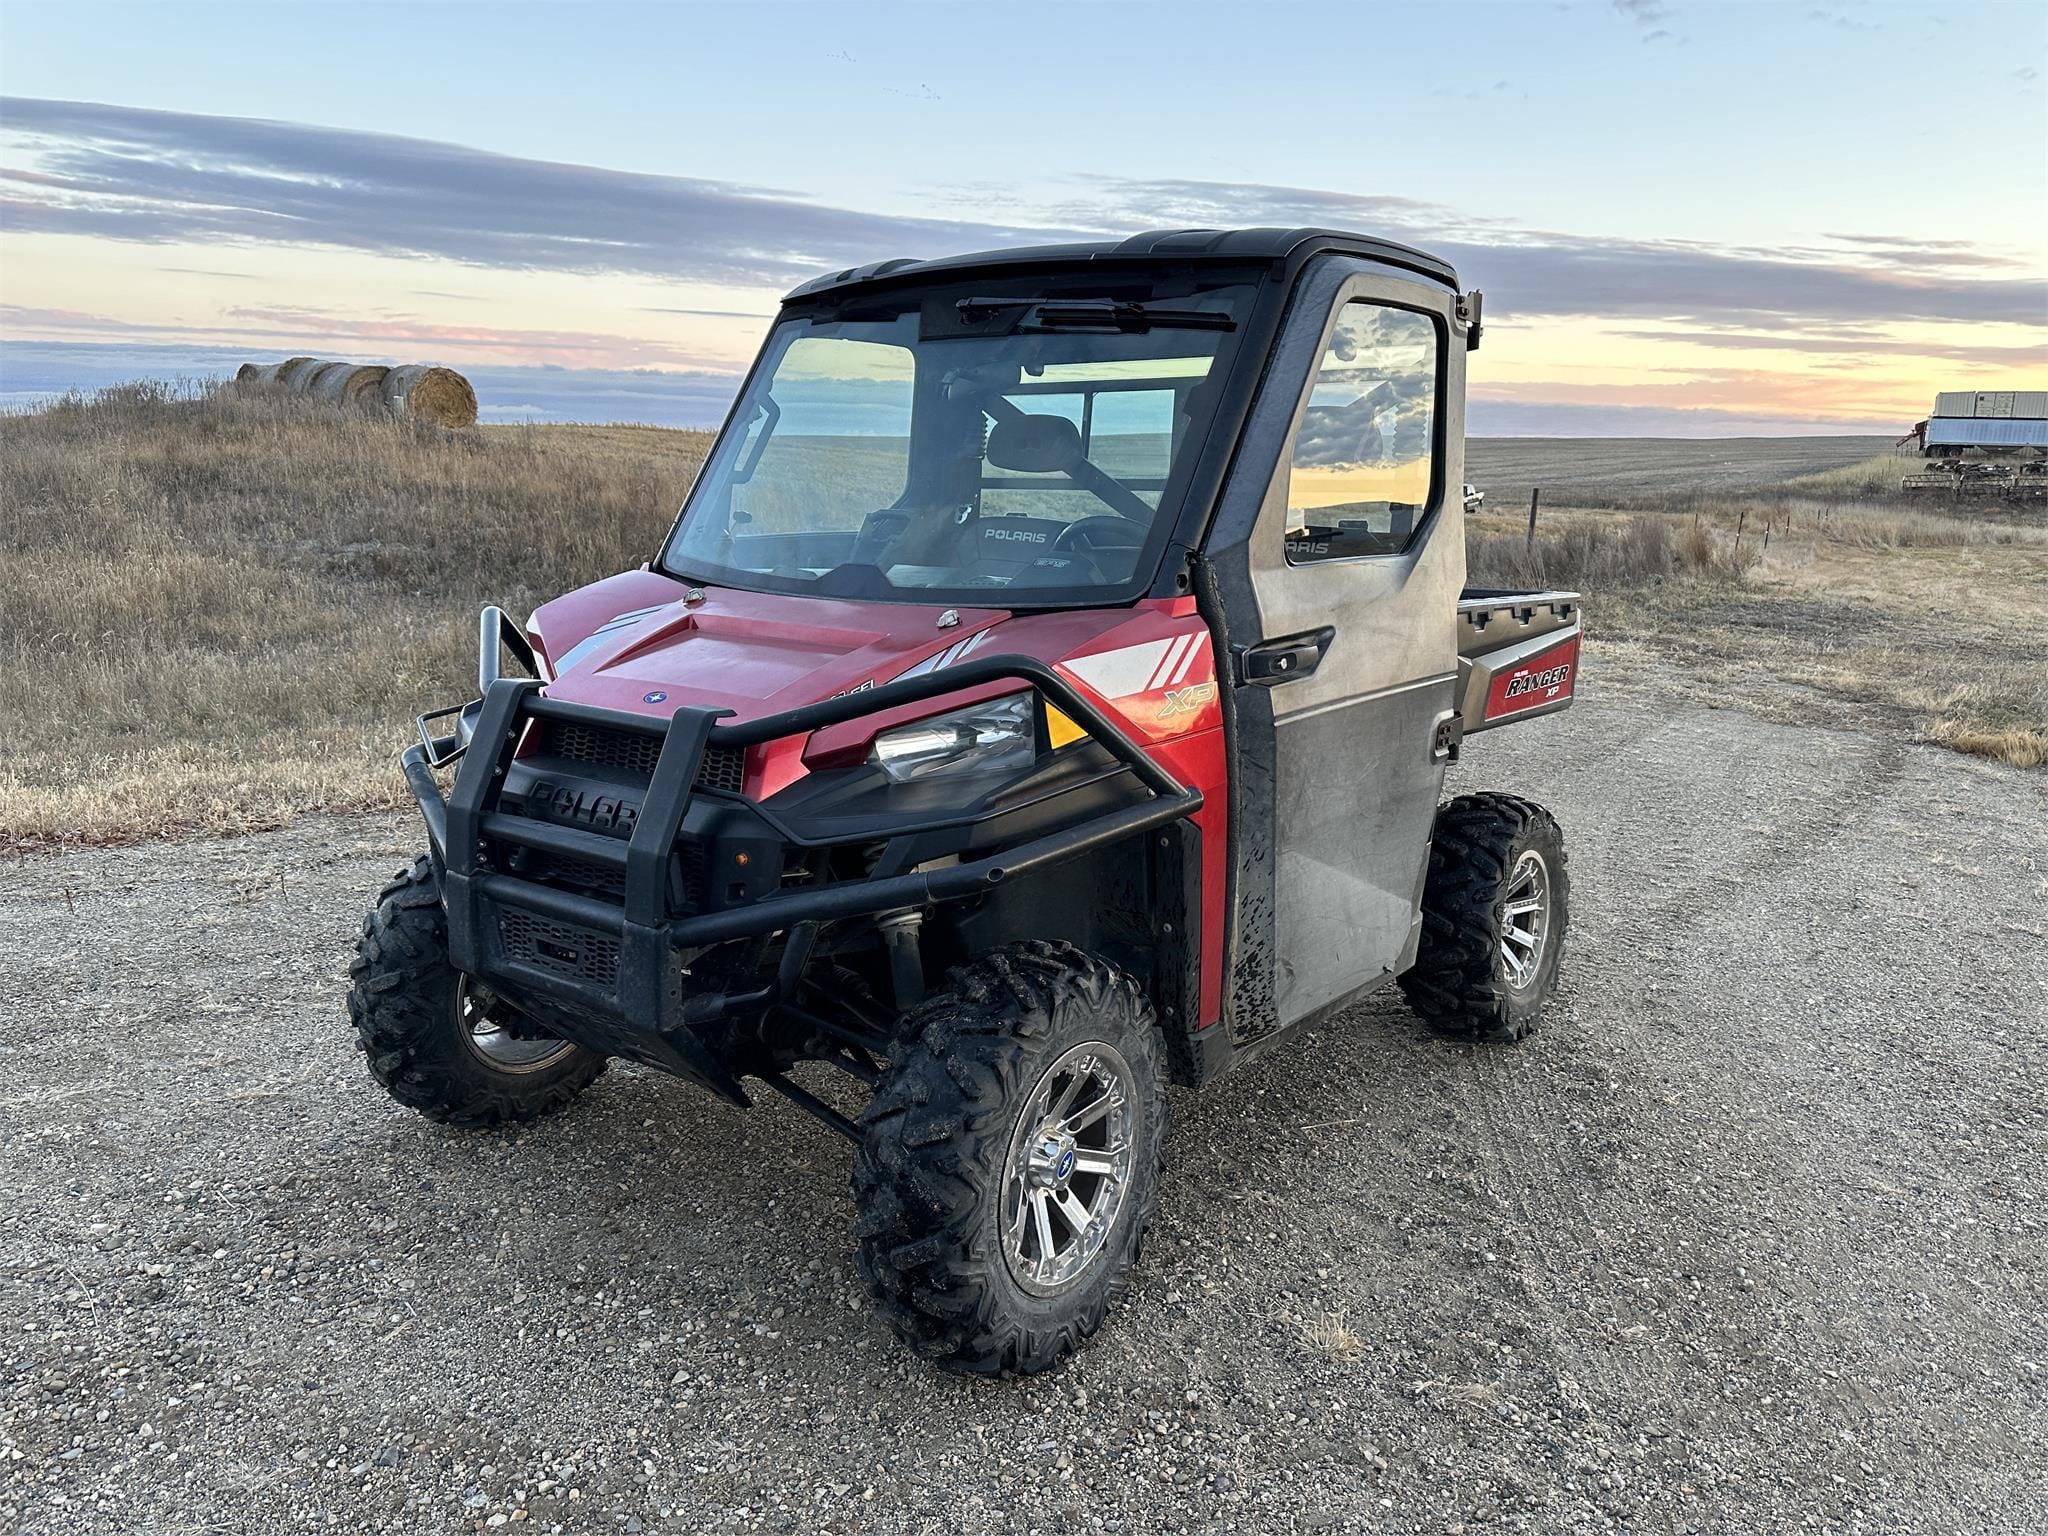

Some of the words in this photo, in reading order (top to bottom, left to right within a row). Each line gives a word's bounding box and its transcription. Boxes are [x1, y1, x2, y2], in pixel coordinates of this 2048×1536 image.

[984, 528, 1047, 544] POLARIS
[1504, 664, 1570, 699] RANGER
[1545, 685, 1560, 698] XP
[1158, 681, 1217, 718] XP
